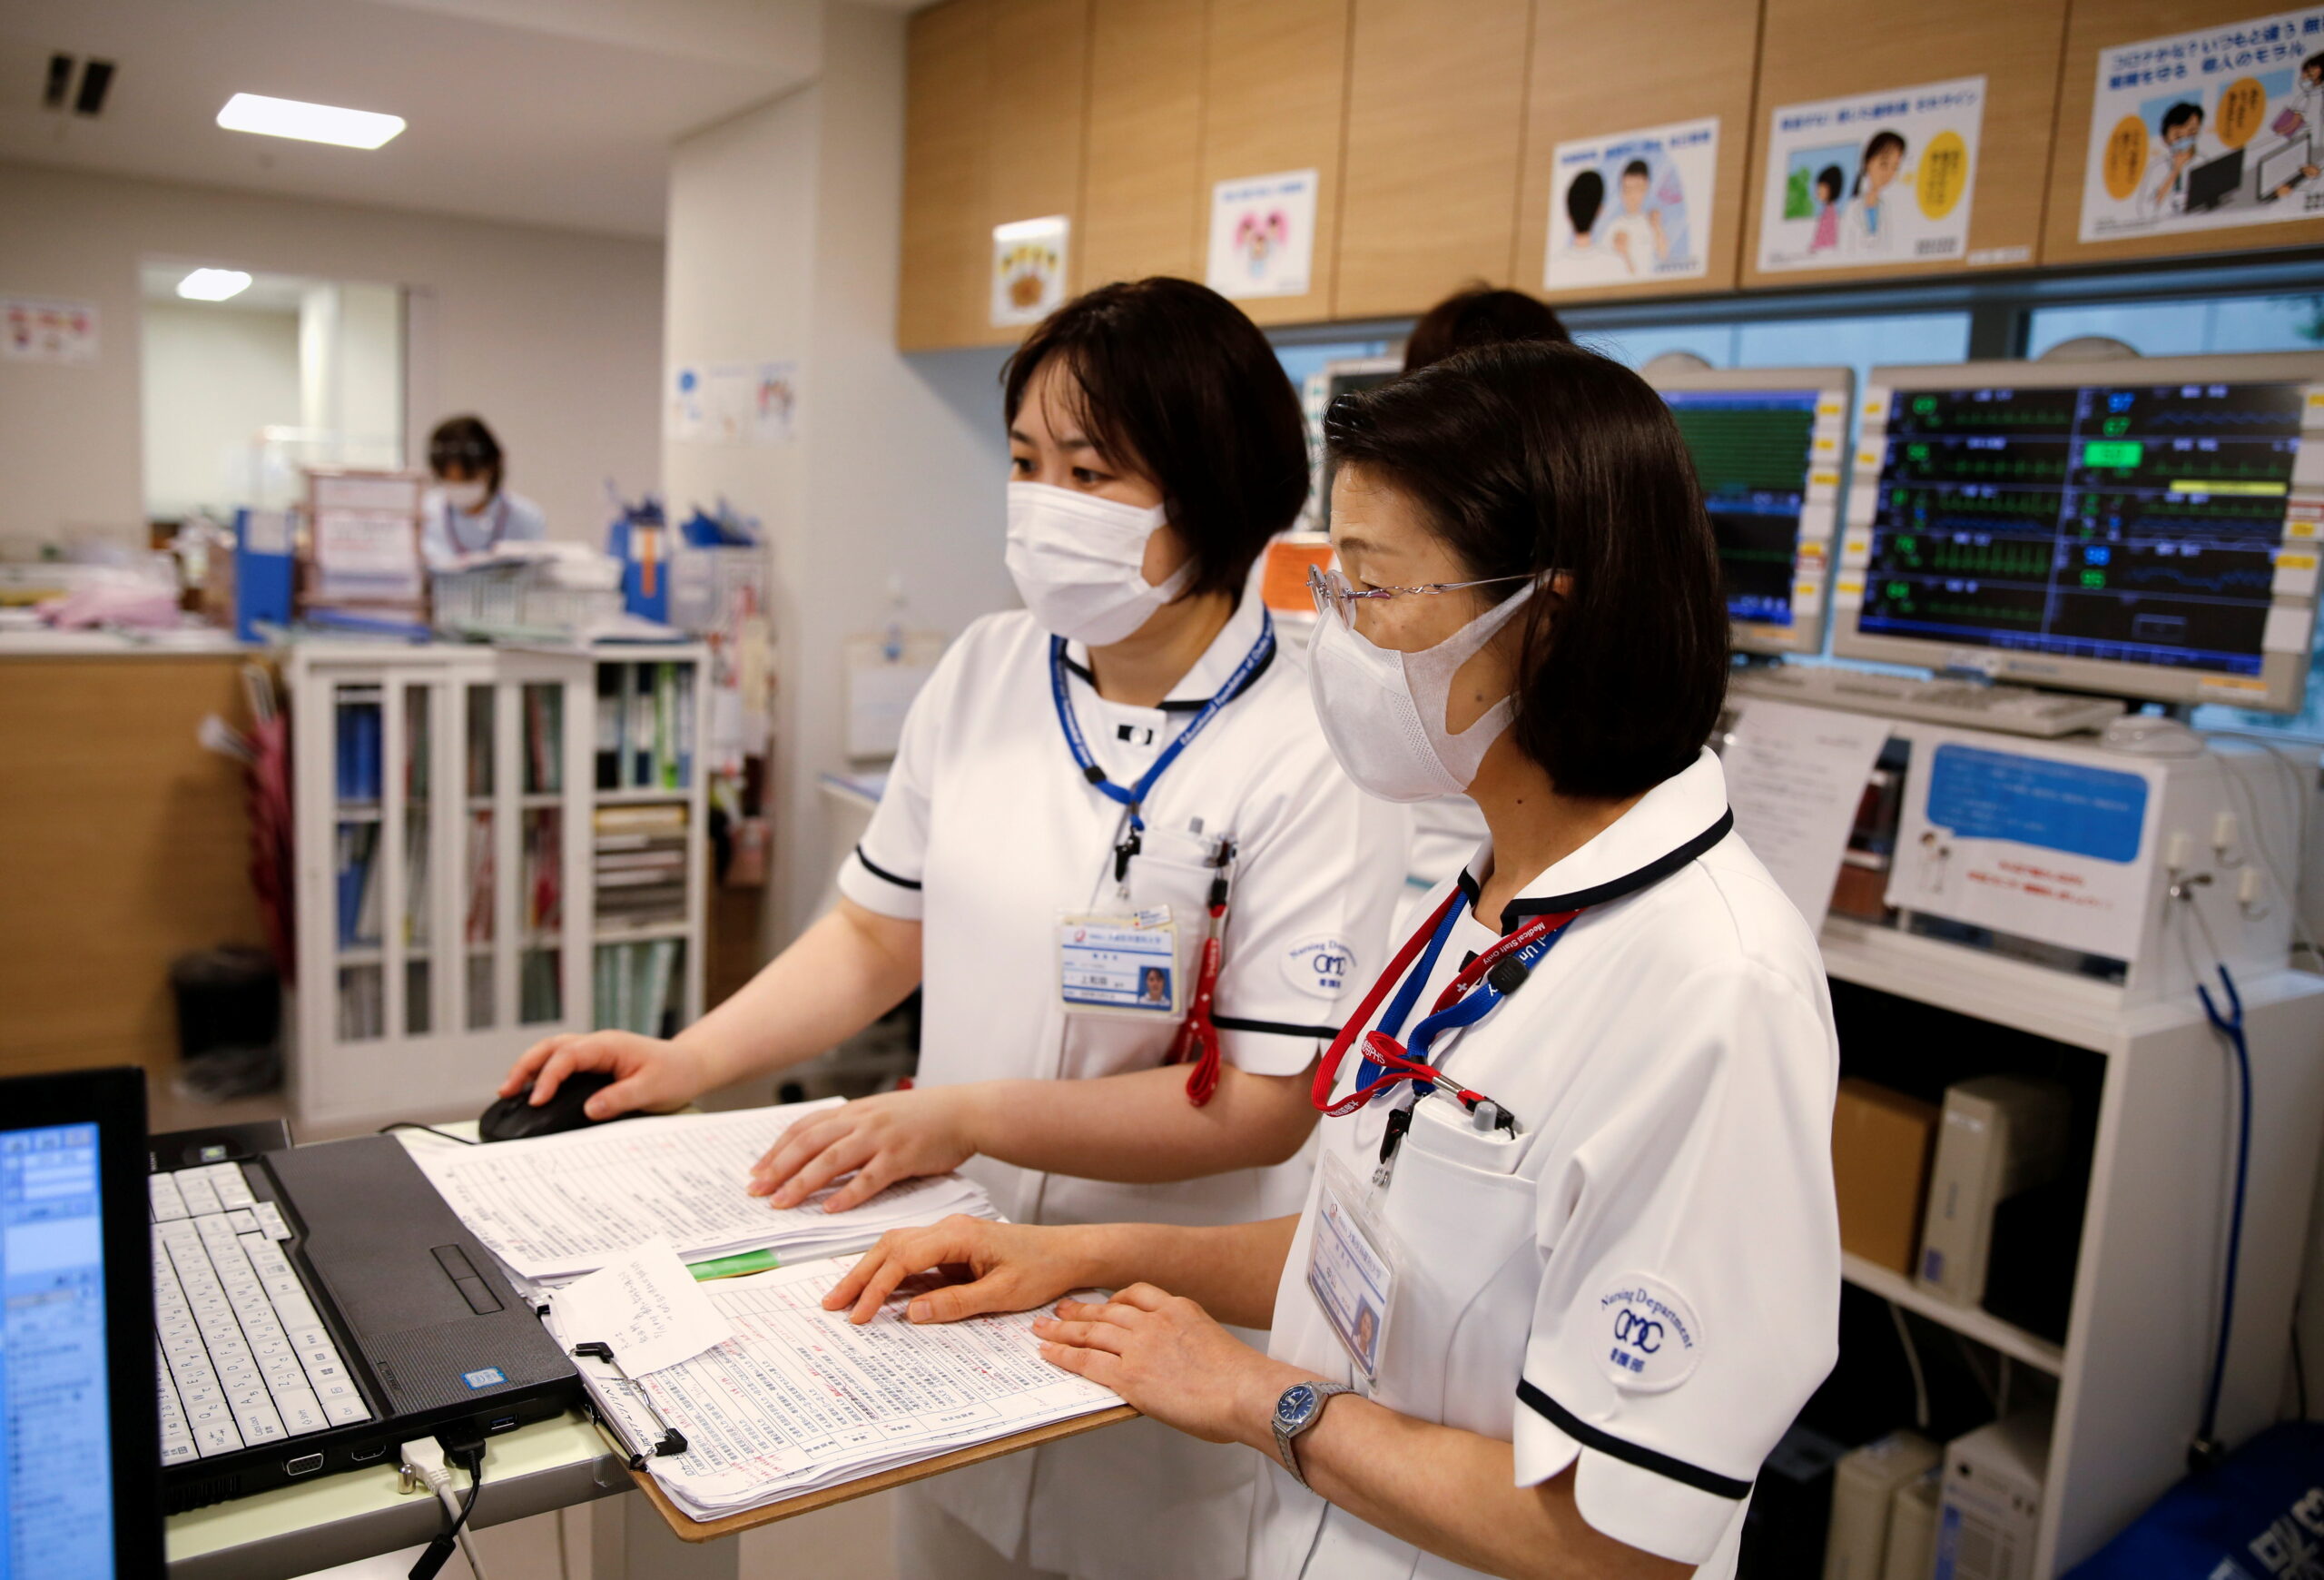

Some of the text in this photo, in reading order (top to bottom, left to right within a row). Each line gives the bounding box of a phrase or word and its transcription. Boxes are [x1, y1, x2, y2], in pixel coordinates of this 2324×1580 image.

[1517, 923, 1545, 943] Medical
[1499, 939, 1519, 953] Staff
[1482, 951, 1500, 965] Only
[1636, 1288, 1692, 1348] Department
